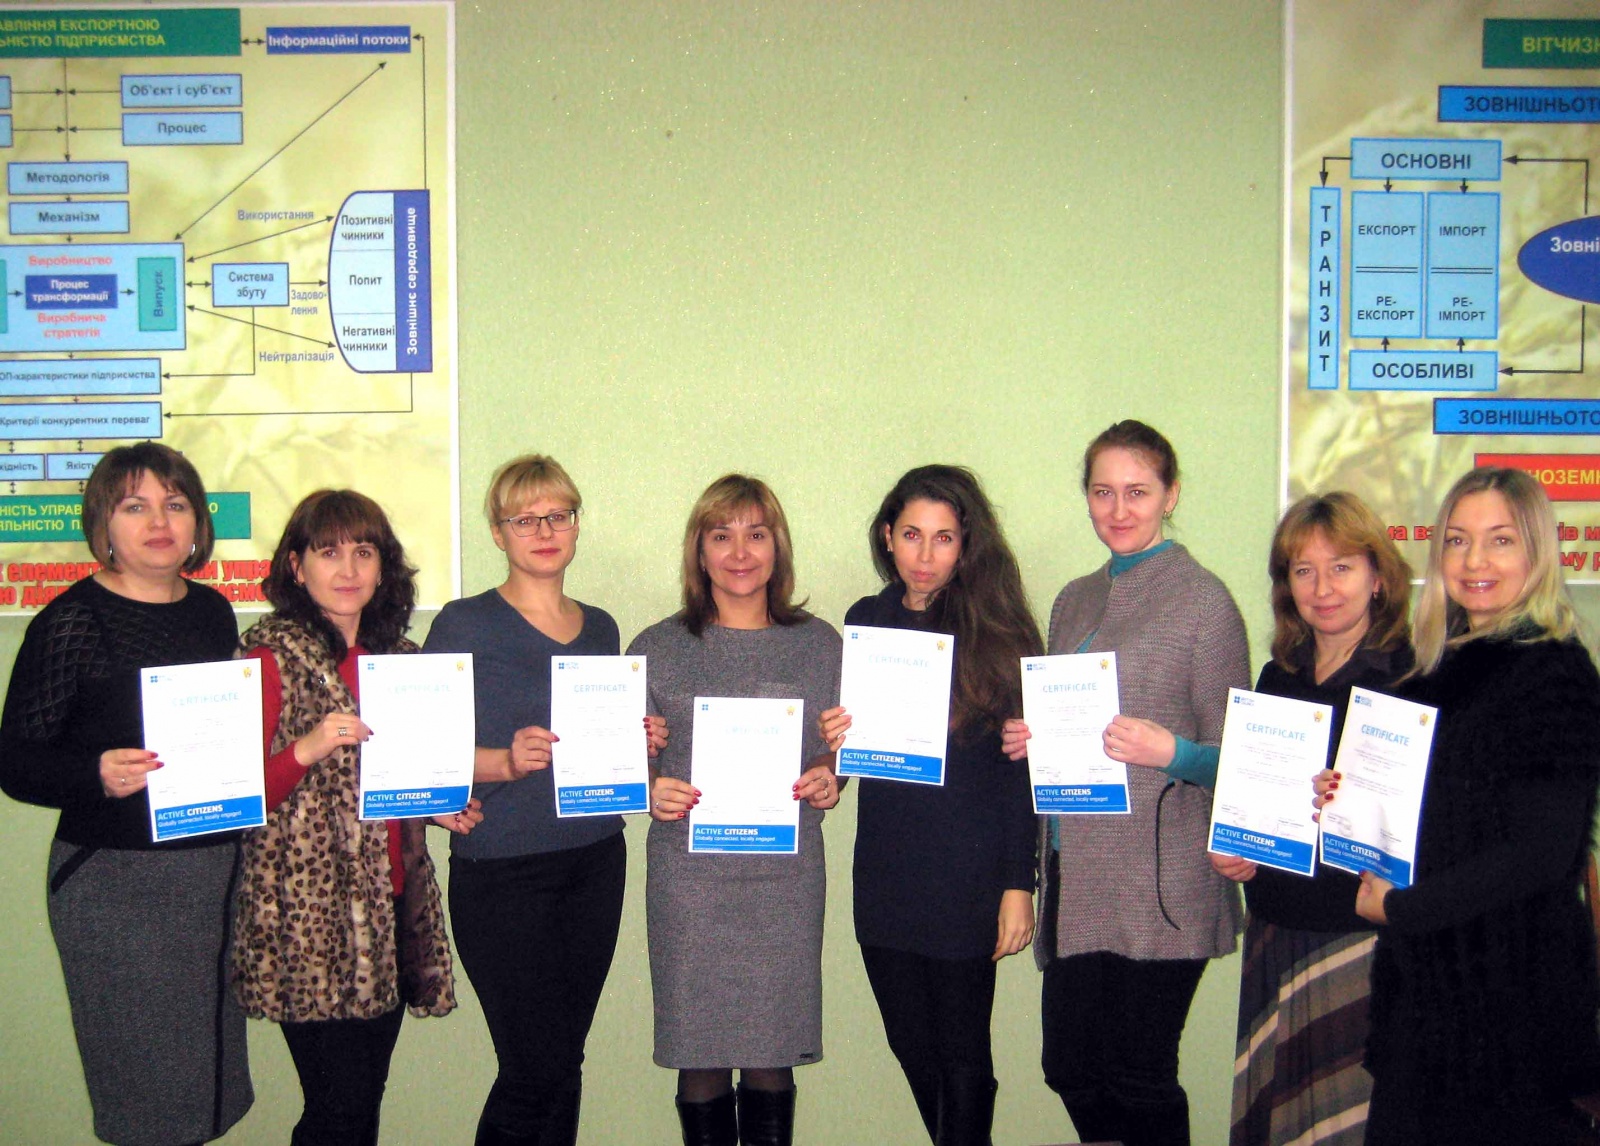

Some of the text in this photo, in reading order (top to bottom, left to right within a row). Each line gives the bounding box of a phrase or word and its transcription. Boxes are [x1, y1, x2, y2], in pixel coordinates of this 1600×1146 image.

[60, 18, 160, 31] ЕКСПОРТНОЮ
[55, 34, 166, 48] ПІДПРИЄМСТВА
[268, 33, 409, 48] Інформаційні потоки
[1464, 96, 1600, 112] ЗОВНІШНЬОТ
[157, 122, 207, 136] Процес
[1381, 153, 1471, 170] ОСНОВНІ
[26, 171, 110, 185] Методологія
[38, 211, 100, 223] Механізм
[237, 209, 314, 221] Використання
[341, 214, 393, 226] Позитивні
[341, 231, 384, 240] чинники
[1358, 225, 1416, 236] ЕКСПОРТ
[1439, 226, 1487, 237] ІМПОРТ
[1549, 236, 1600, 253] Зовні
[28, 255, 113, 267] Виробництво
[228, 271, 274, 282] Система
[349, 275, 382, 286] Попит
[406, 207, 419, 355] Зовнішнє середовище
[51, 279, 90, 290] Процес
[32, 291, 109, 303] трансформації
[153, 270, 165, 318] Випуск
[237, 287, 267, 299] збуту
[1376, 296, 1397, 306] РЕ-
[1452, 297, 1473, 307] РЕ-
[291, 306, 318, 315] лення
[1357, 310, 1415, 320] ЕКСПОРТ
[1439, 311, 1486, 321] ІМПОРТ
[37, 312, 107, 325] Виробнича
[44, 328, 100, 339] стратегія
[342, 326, 396, 337] Негативні
[343, 342, 388, 351] чинники
[259, 351, 335, 363] Нейтралізація
[1372, 363, 1474, 378] ОСОБЛИВІ
[42, 417, 108, 426] конкурентних
[111, 416, 150, 425] переваг
[7, 562, 106, 582] елемент
[574, 684, 627, 693] CERTIFICATE
[1042, 682, 1097, 693] CERTIFICATE
[171, 691, 240, 707] CERTIFICATE
[1246, 722, 1306, 742] CERTIFICATE
[1361, 724, 1410, 746] CERTIFICATE
[842, 752, 905, 764] ACTIVE CITIZENS
[366, 791, 432, 802] ACTIVE CITIZENS
[560, 788, 614, 798] ACTIVE CITIZENS
[1060, 788, 1091, 796] CITIZENS
[157, 804, 223, 820] ACTIVE CITIZENS
[724, 828, 758, 836] CITIZENS
[1215, 827, 1276, 847] ACTIVE CITIZENS
[1325, 837, 1381, 860] ACTIVE CITIZENS
